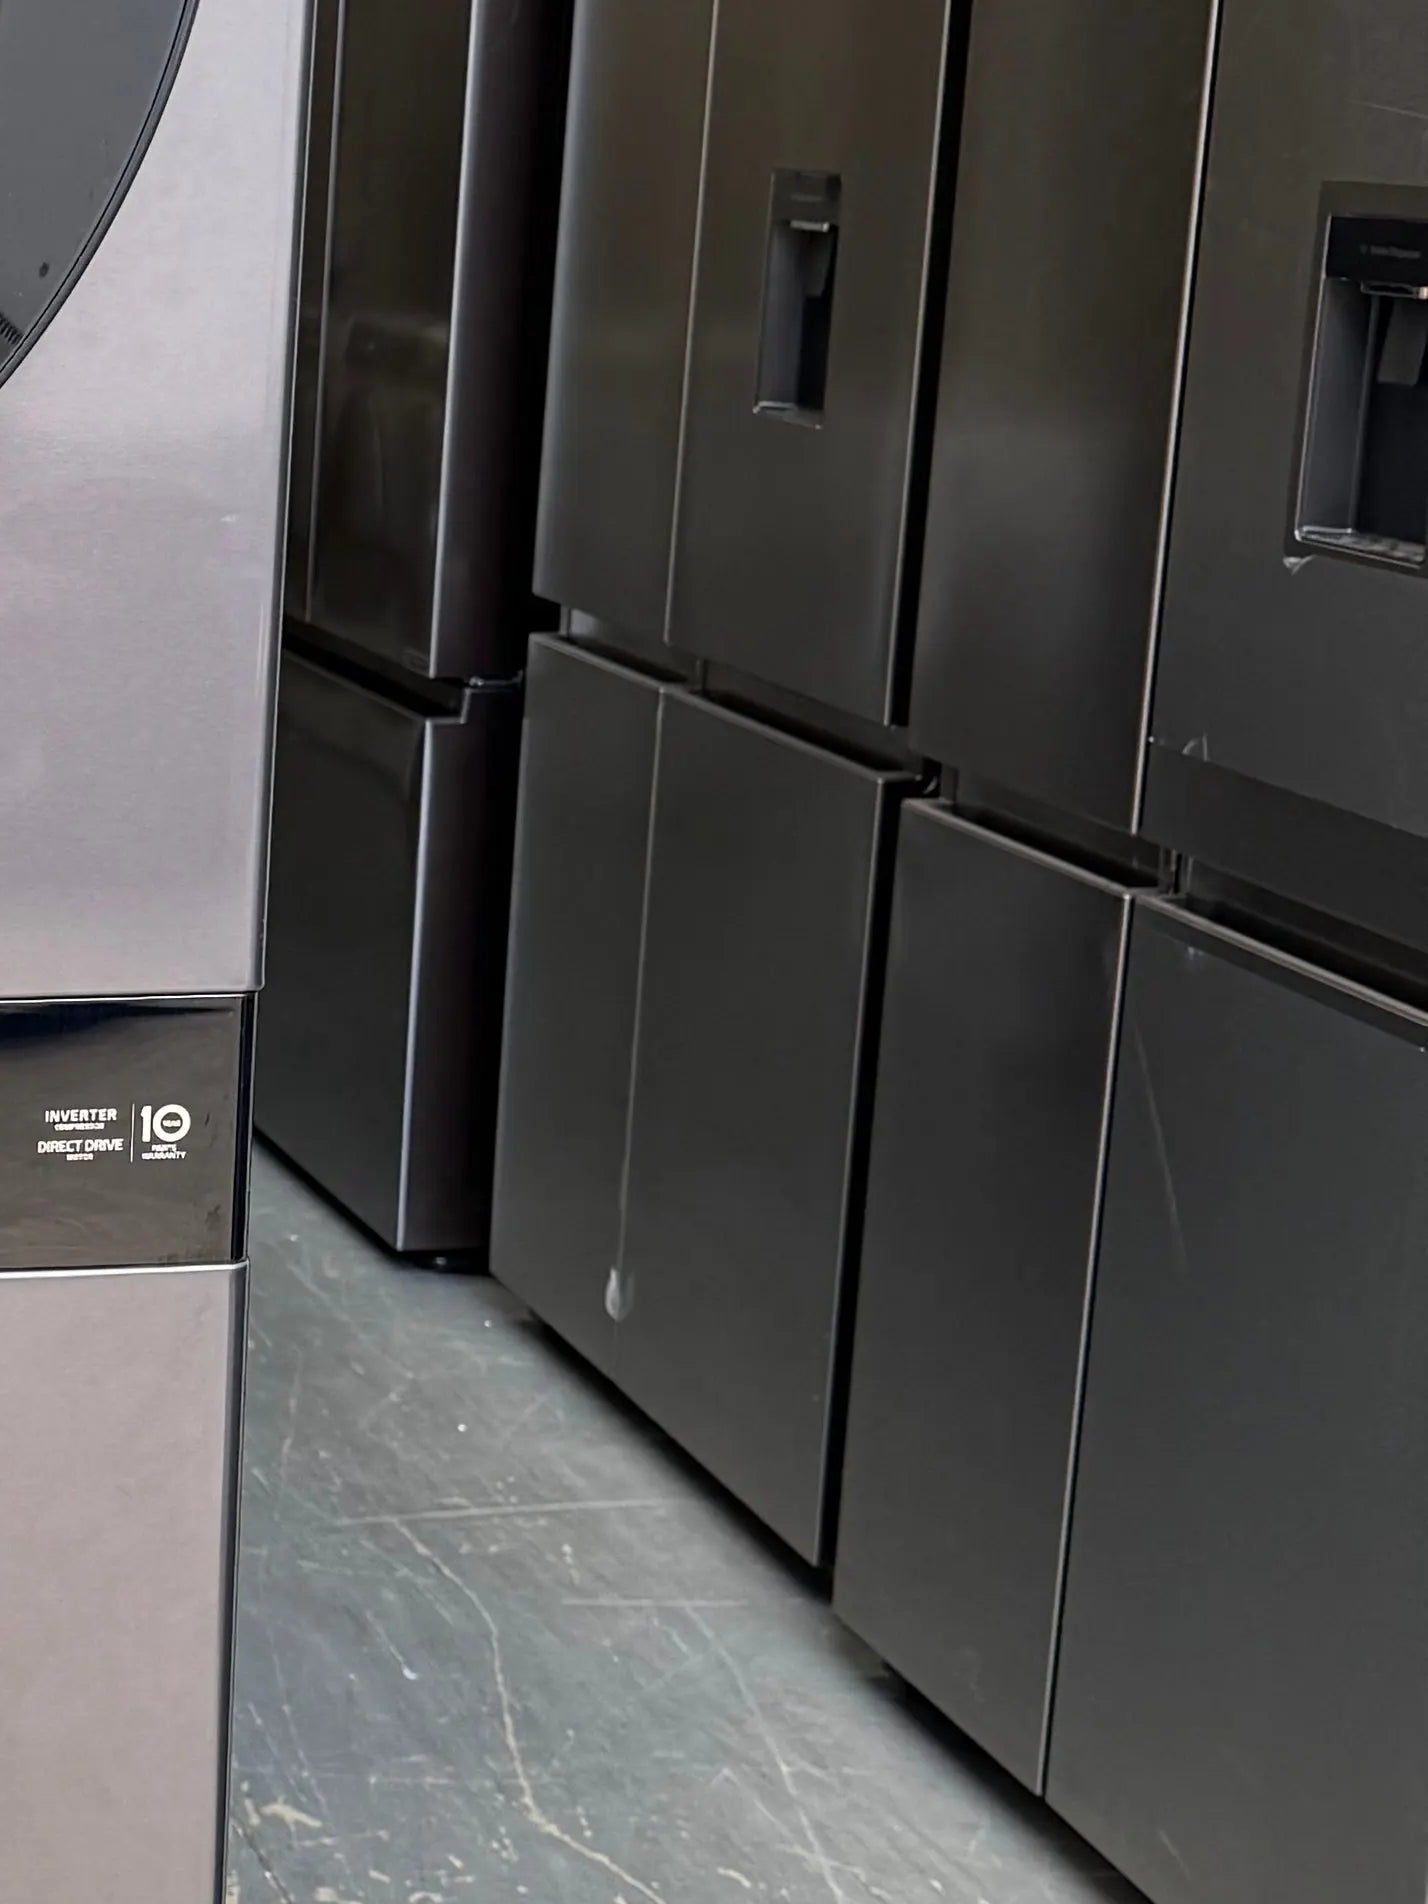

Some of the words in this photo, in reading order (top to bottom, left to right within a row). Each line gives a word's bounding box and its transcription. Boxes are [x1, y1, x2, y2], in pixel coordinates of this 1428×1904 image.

[44, 1108, 118, 1123] INVERTER
[140, 1103, 192, 1143] 10
[37, 1139, 83, 1154] DIRECT
[84, 1138, 124, 1153] DRIVE
